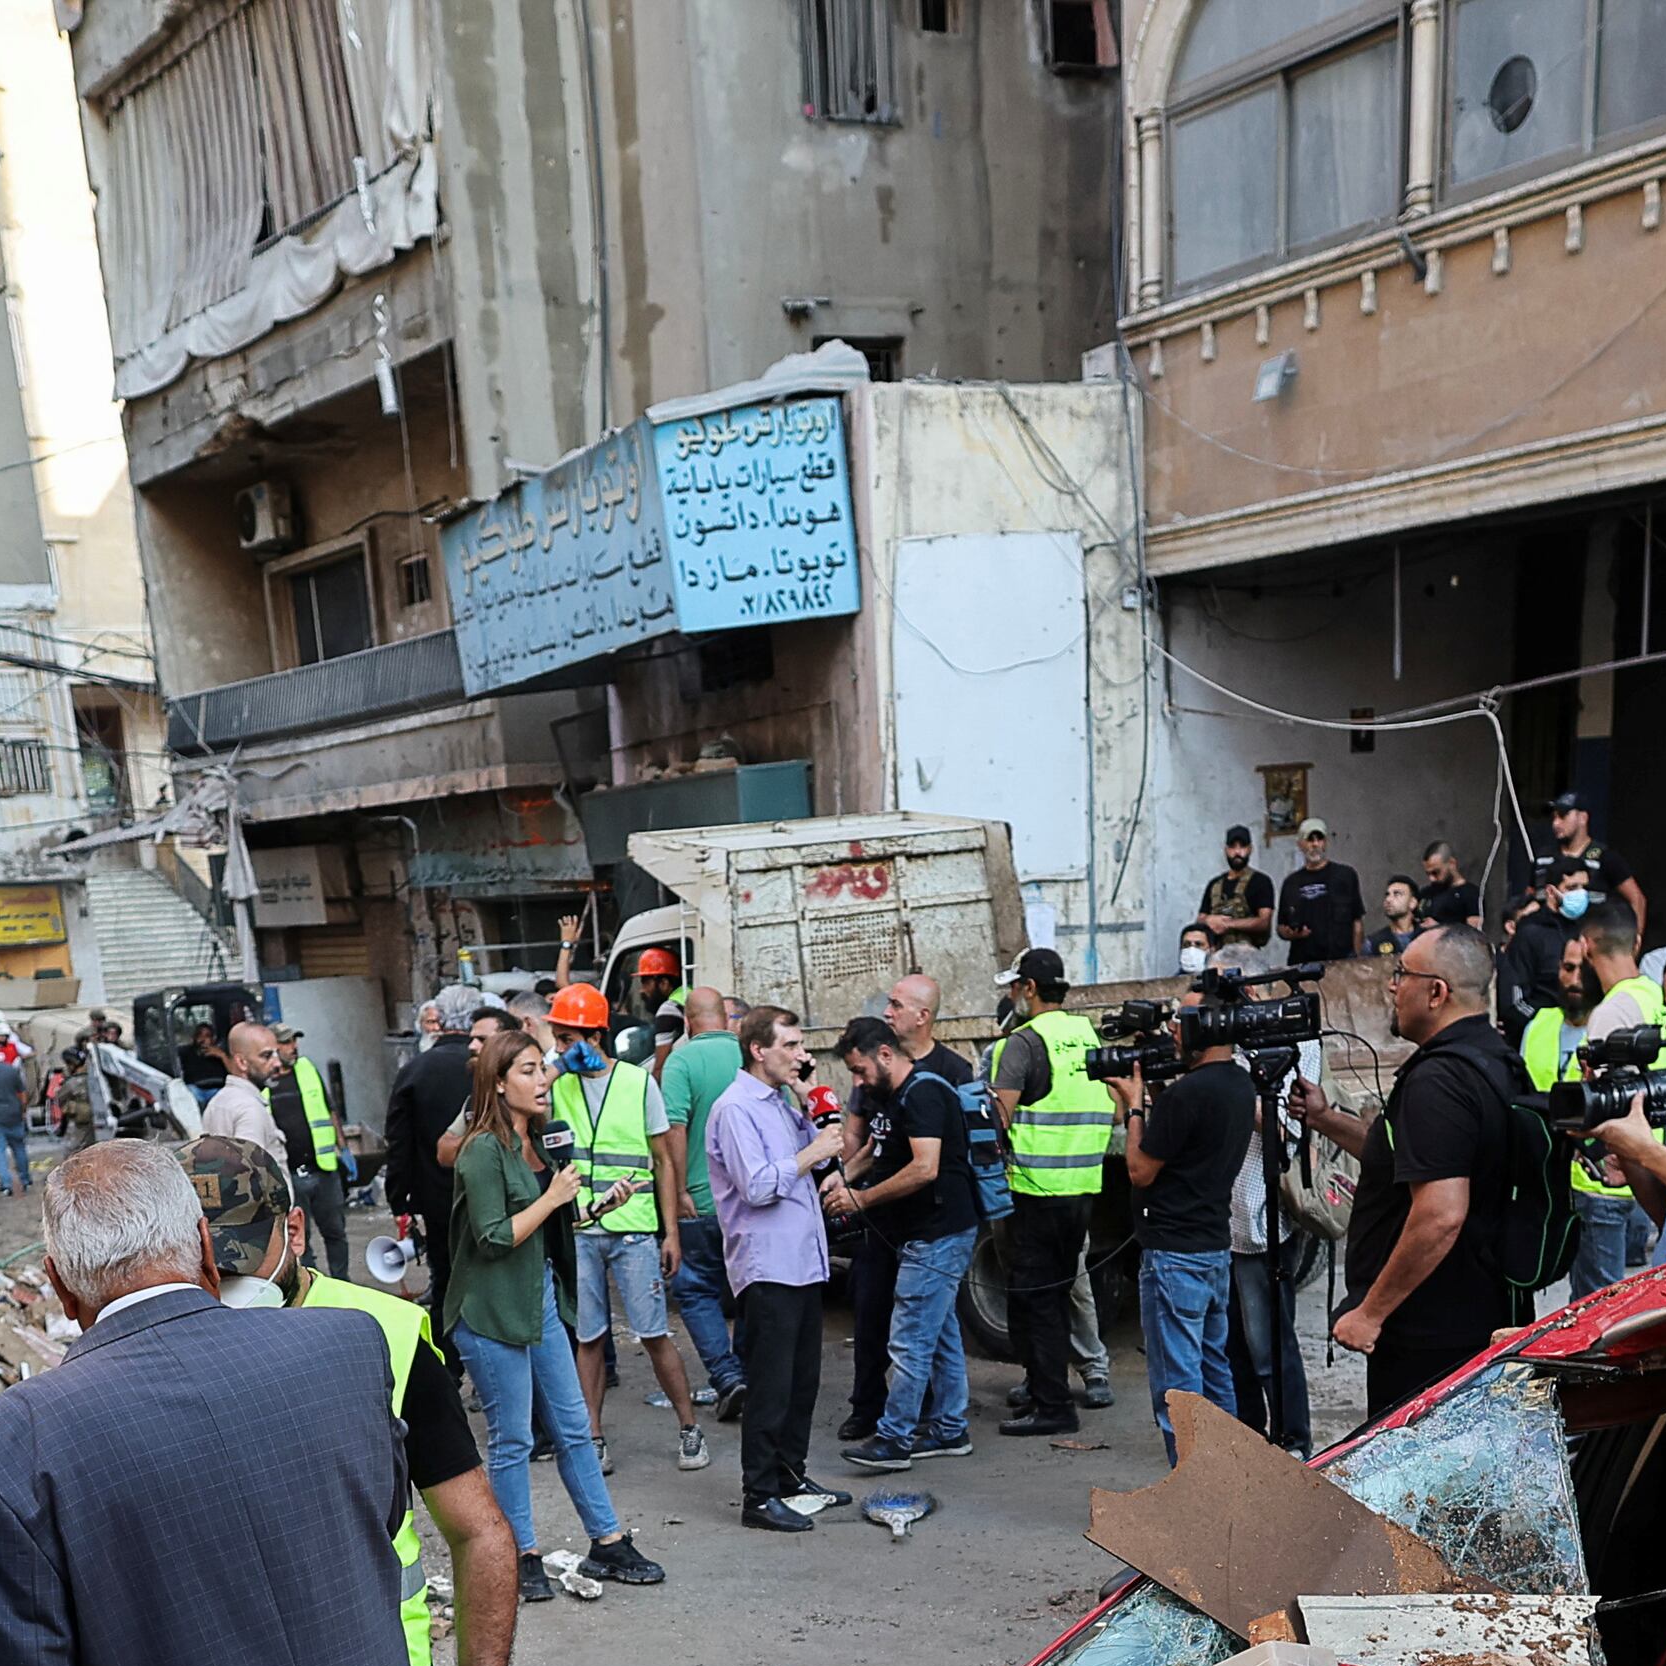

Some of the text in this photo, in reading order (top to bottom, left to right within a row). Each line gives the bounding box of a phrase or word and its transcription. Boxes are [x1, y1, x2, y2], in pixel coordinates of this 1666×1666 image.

[666, 452, 836, 506] قطع سيارات يابانية
